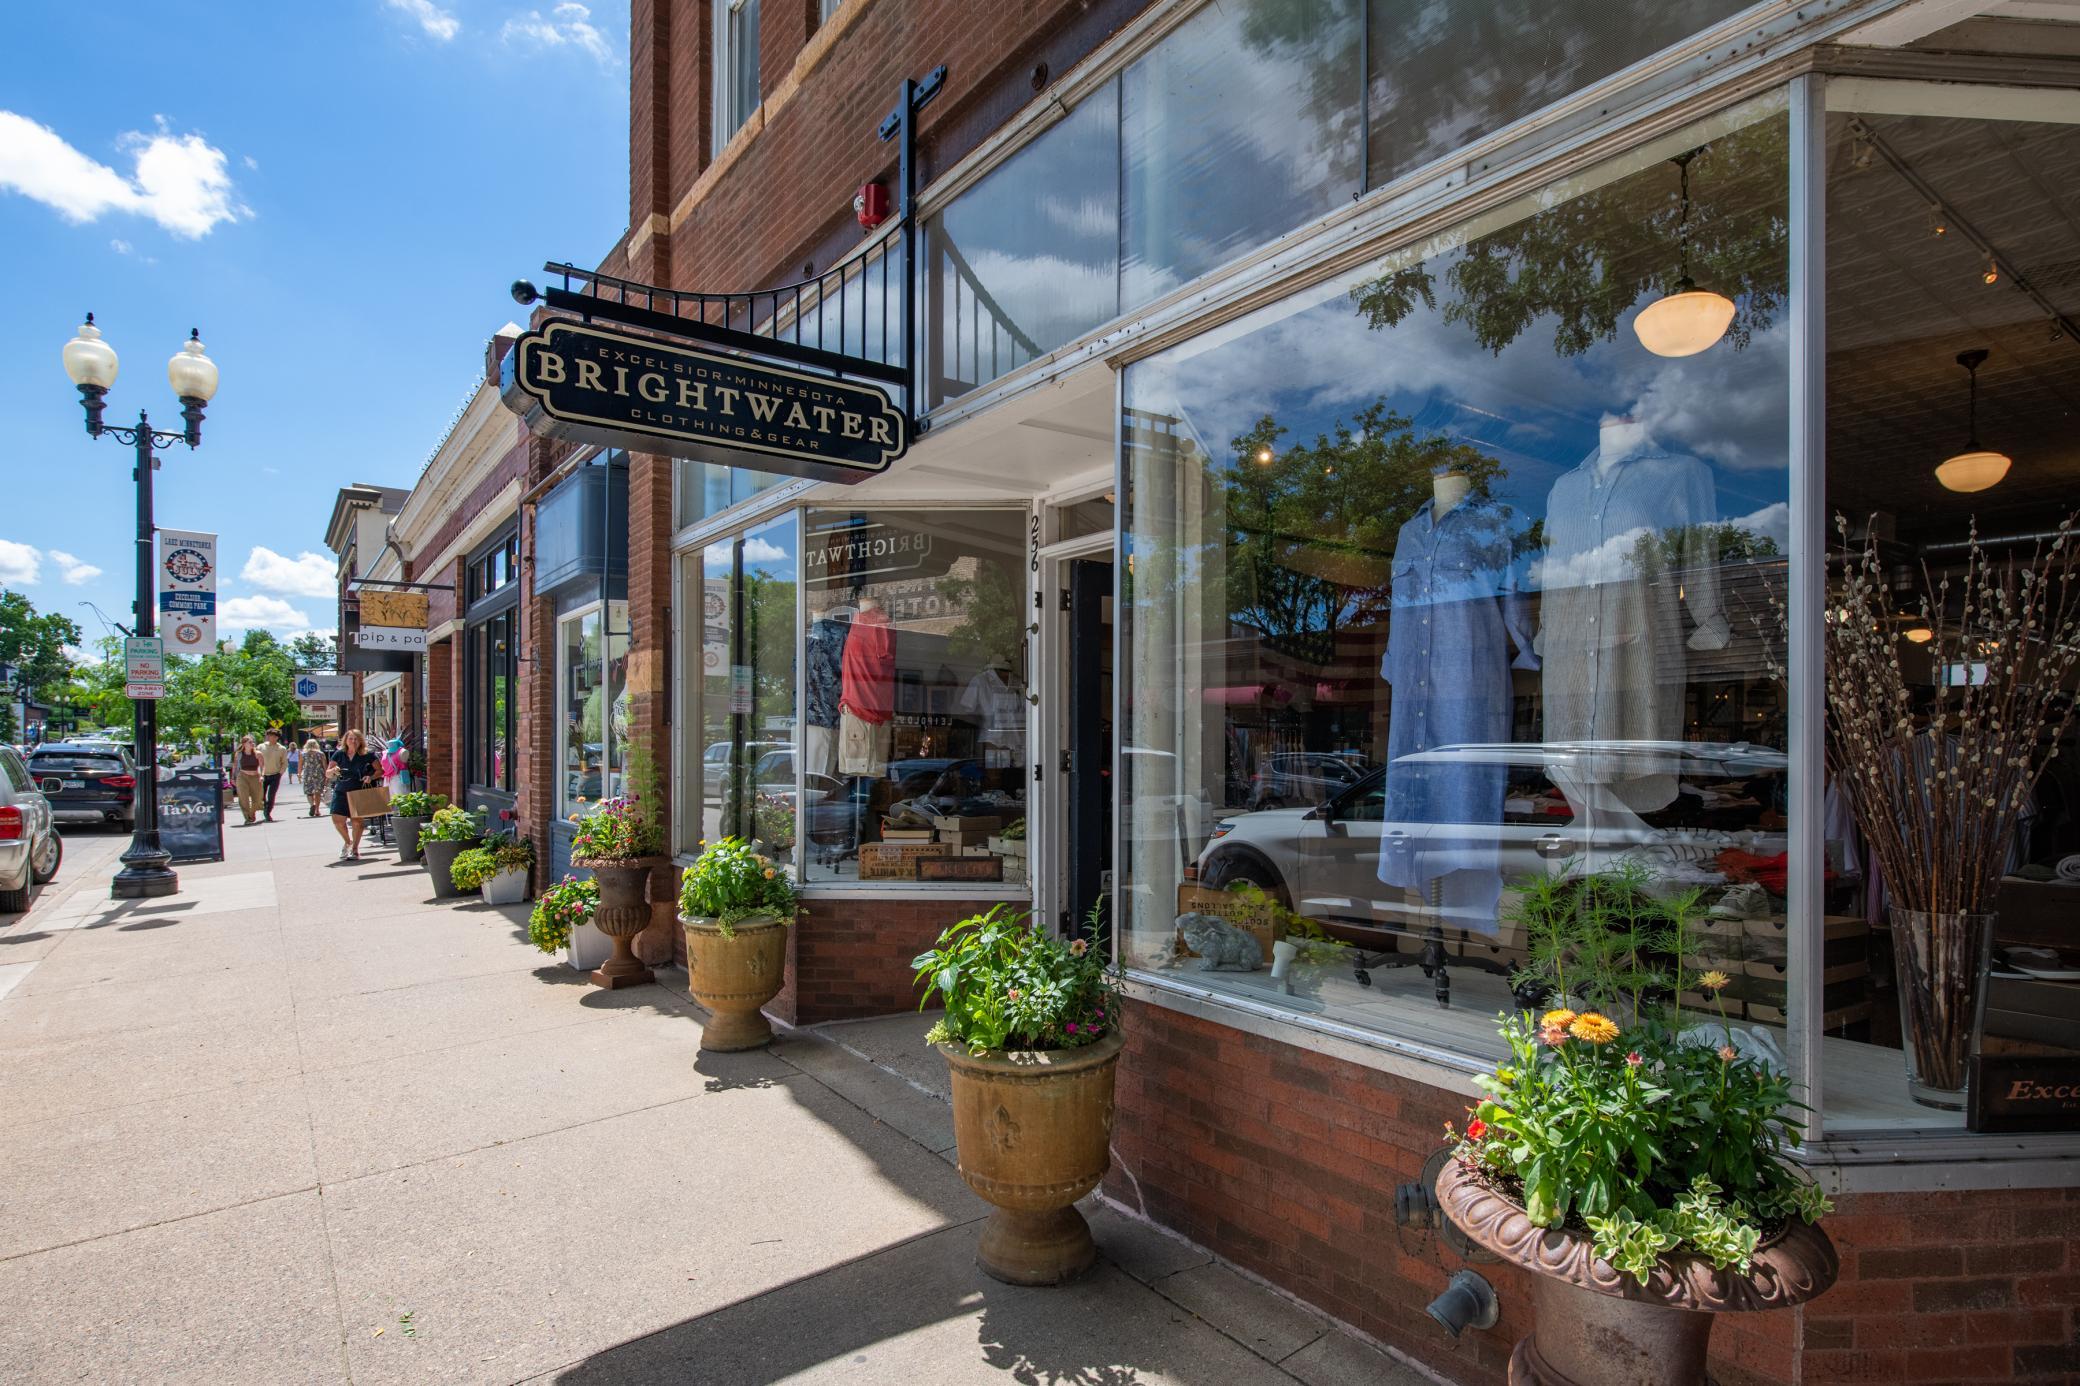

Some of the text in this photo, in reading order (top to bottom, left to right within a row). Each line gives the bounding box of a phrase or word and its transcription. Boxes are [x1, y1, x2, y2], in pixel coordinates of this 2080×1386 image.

[536, 351, 893, 445] BRIGHTWATER
[600, 349, 845, 406] EXCELSIOR MINNESOTA
[631, 409, 745, 436] CLOTHING
[768, 433, 819, 450] GEAR
[165, 538, 178, 546] LAKE
[1031, 515, 1040, 572] 256
[194, 602, 207, 610] PARK
[361, 632, 427, 646] pip & pal
